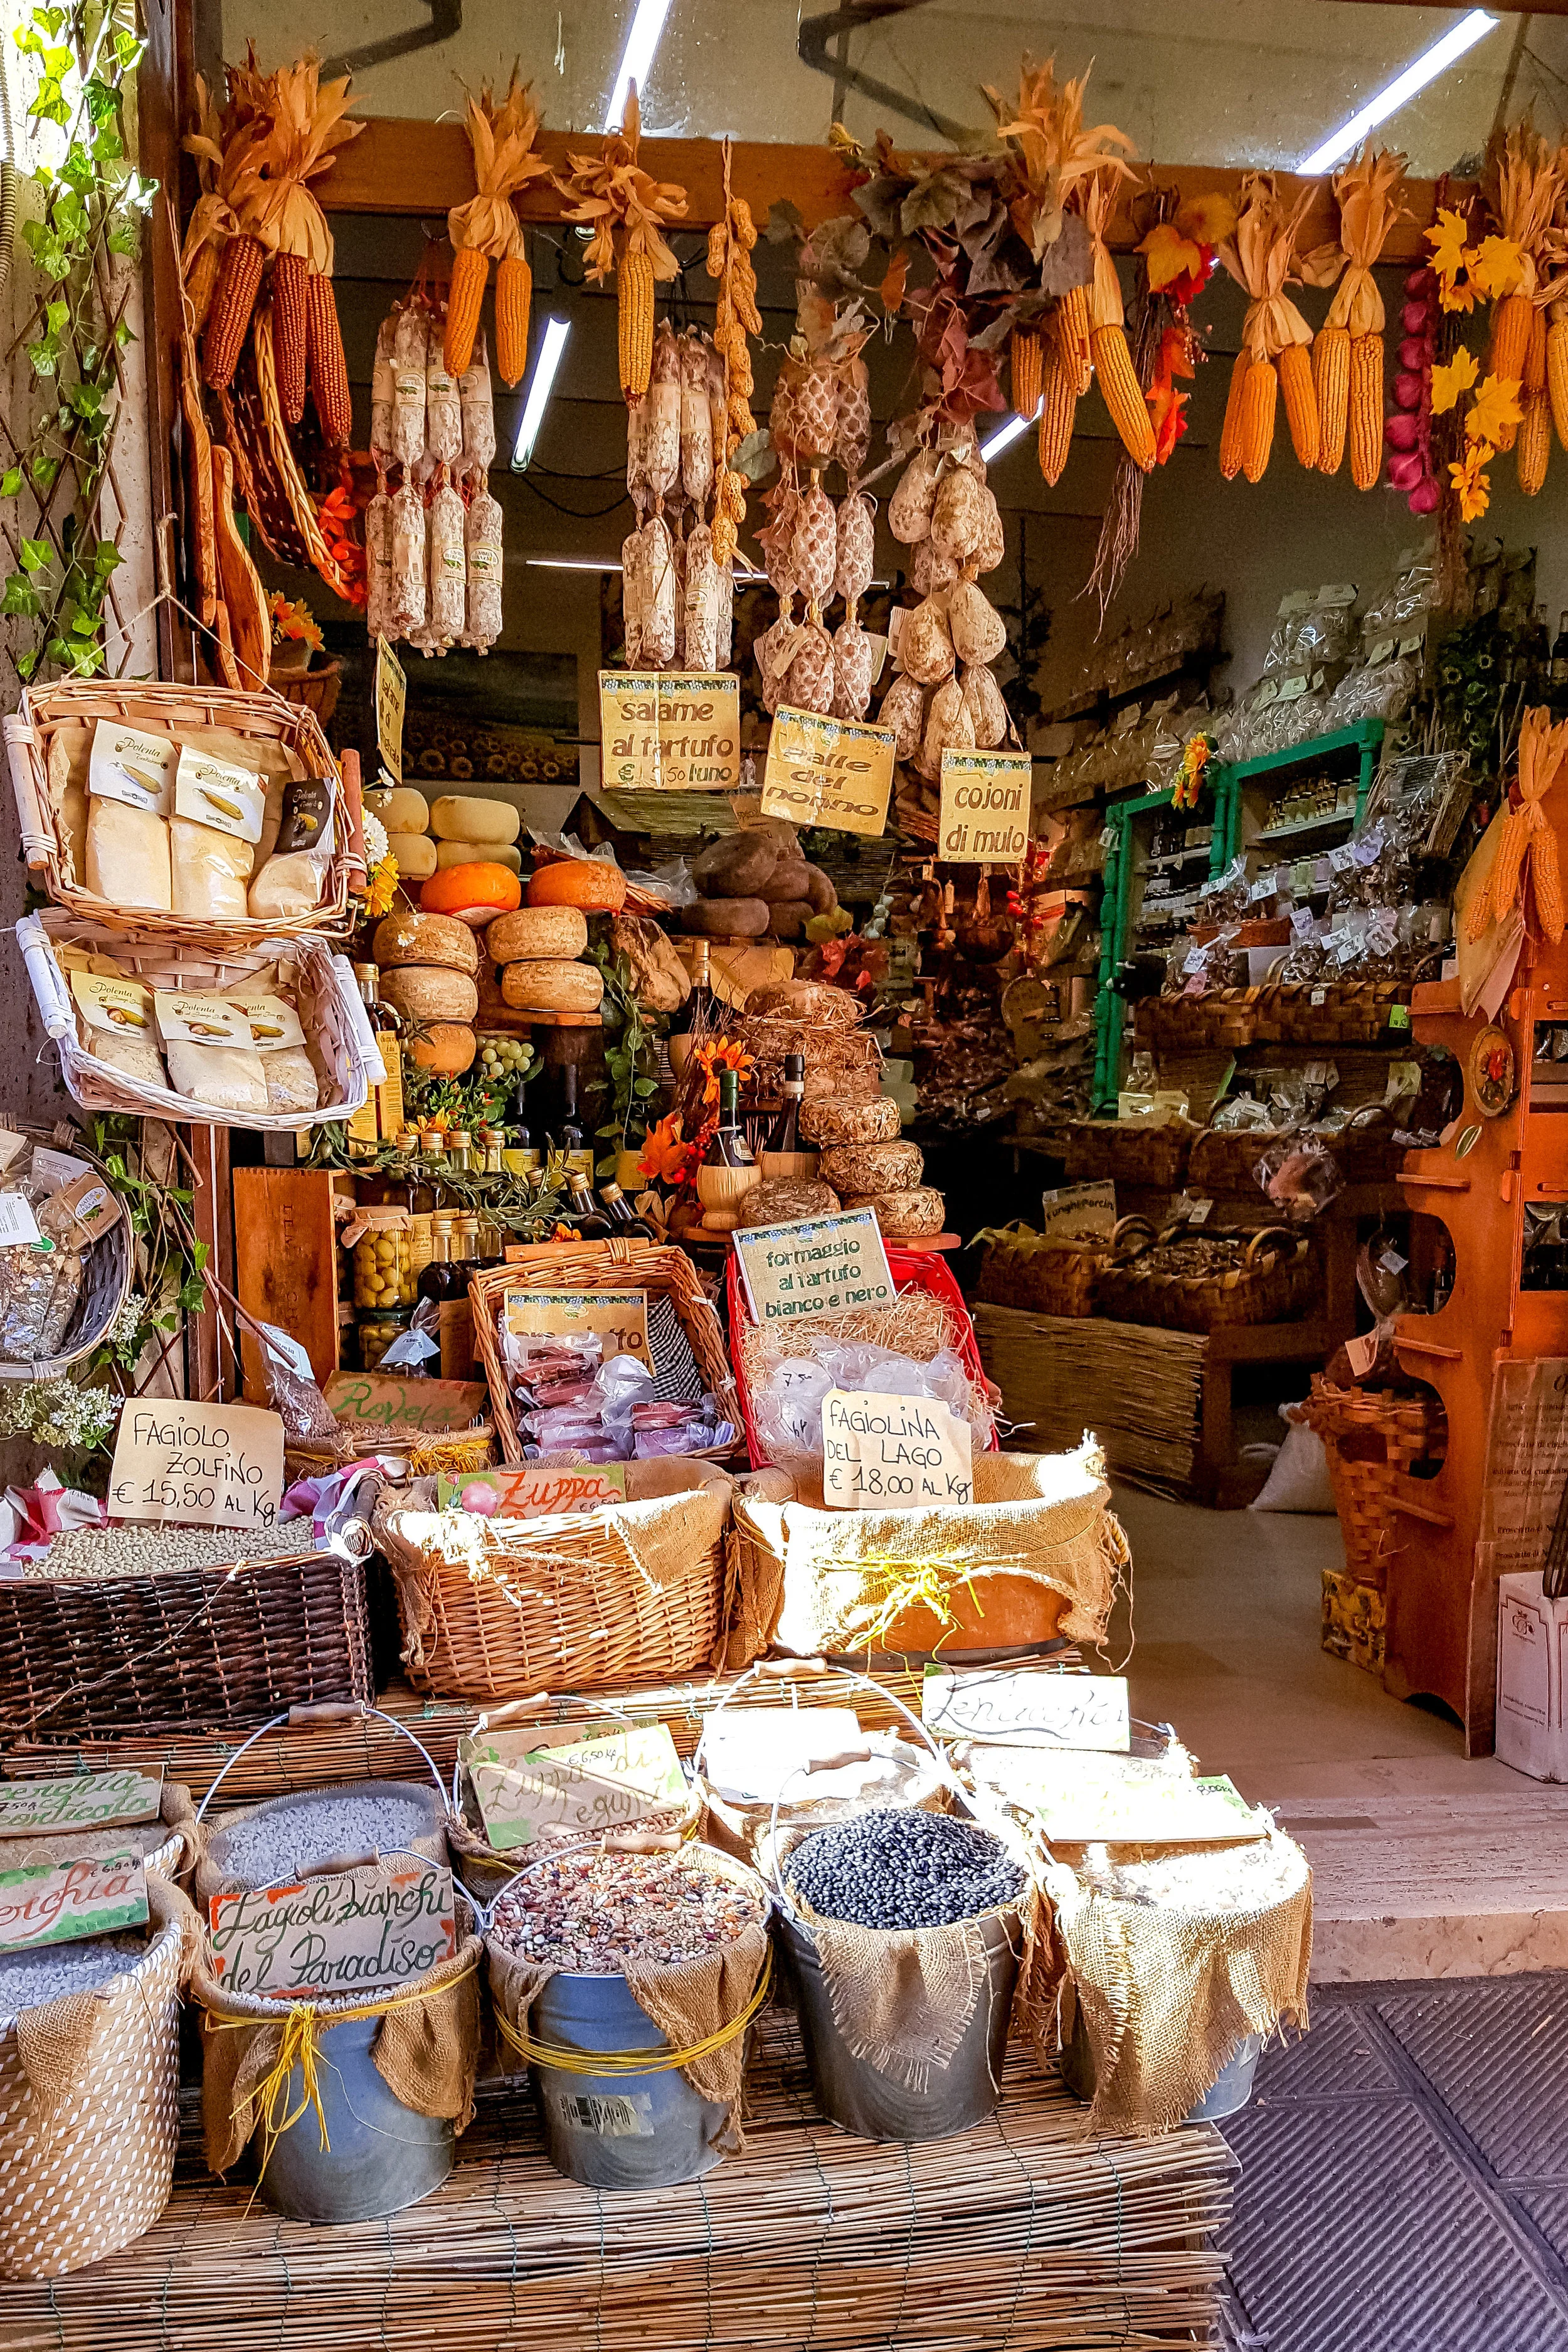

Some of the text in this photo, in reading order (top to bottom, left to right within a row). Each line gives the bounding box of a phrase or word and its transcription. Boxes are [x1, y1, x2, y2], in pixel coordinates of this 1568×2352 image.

[621, 698, 714, 721] salame
[117, 737, 161, 757] Polenta
[612, 734, 734, 757] al tartufo
[199, 764, 241, 786] Polenta
[618, 763, 635, 782] €
[689, 763, 732, 782] l'uno
[791, 770, 848, 790] del
[766, 787, 878, 816] nonno
[955, 781, 1024, 810] cojoni
[946, 824, 1025, 853] di mulo
[89, 982, 133, 998] Polenta
[172, 1000, 216, 1014] Polenta
[245, 1003, 266, 1012] enta
[766, 1238, 860, 1268] formaggio
[778, 1263, 861, 1291] al tartufo
[765, 1285, 887, 1318] bianco e nero
[134, 1412, 230, 1448] FAGIOLO
[830, 1400, 940, 1440] FAGIOLINA
[827, 1439, 942, 1466] DEL LAGO
[166, 1451, 262, 1485] ZOLFINO
[500, 1471, 622, 1514] Zuppa
[829, 1469, 972, 1504] € 18,00 AL Kg
[112, 1479, 276, 1528] € 15,50 AL Kg
[581, 1751, 603, 1763] 6,50
[335, 1870, 453, 1927] bianchi
[220, 1920, 447, 1993] del Paradiso
